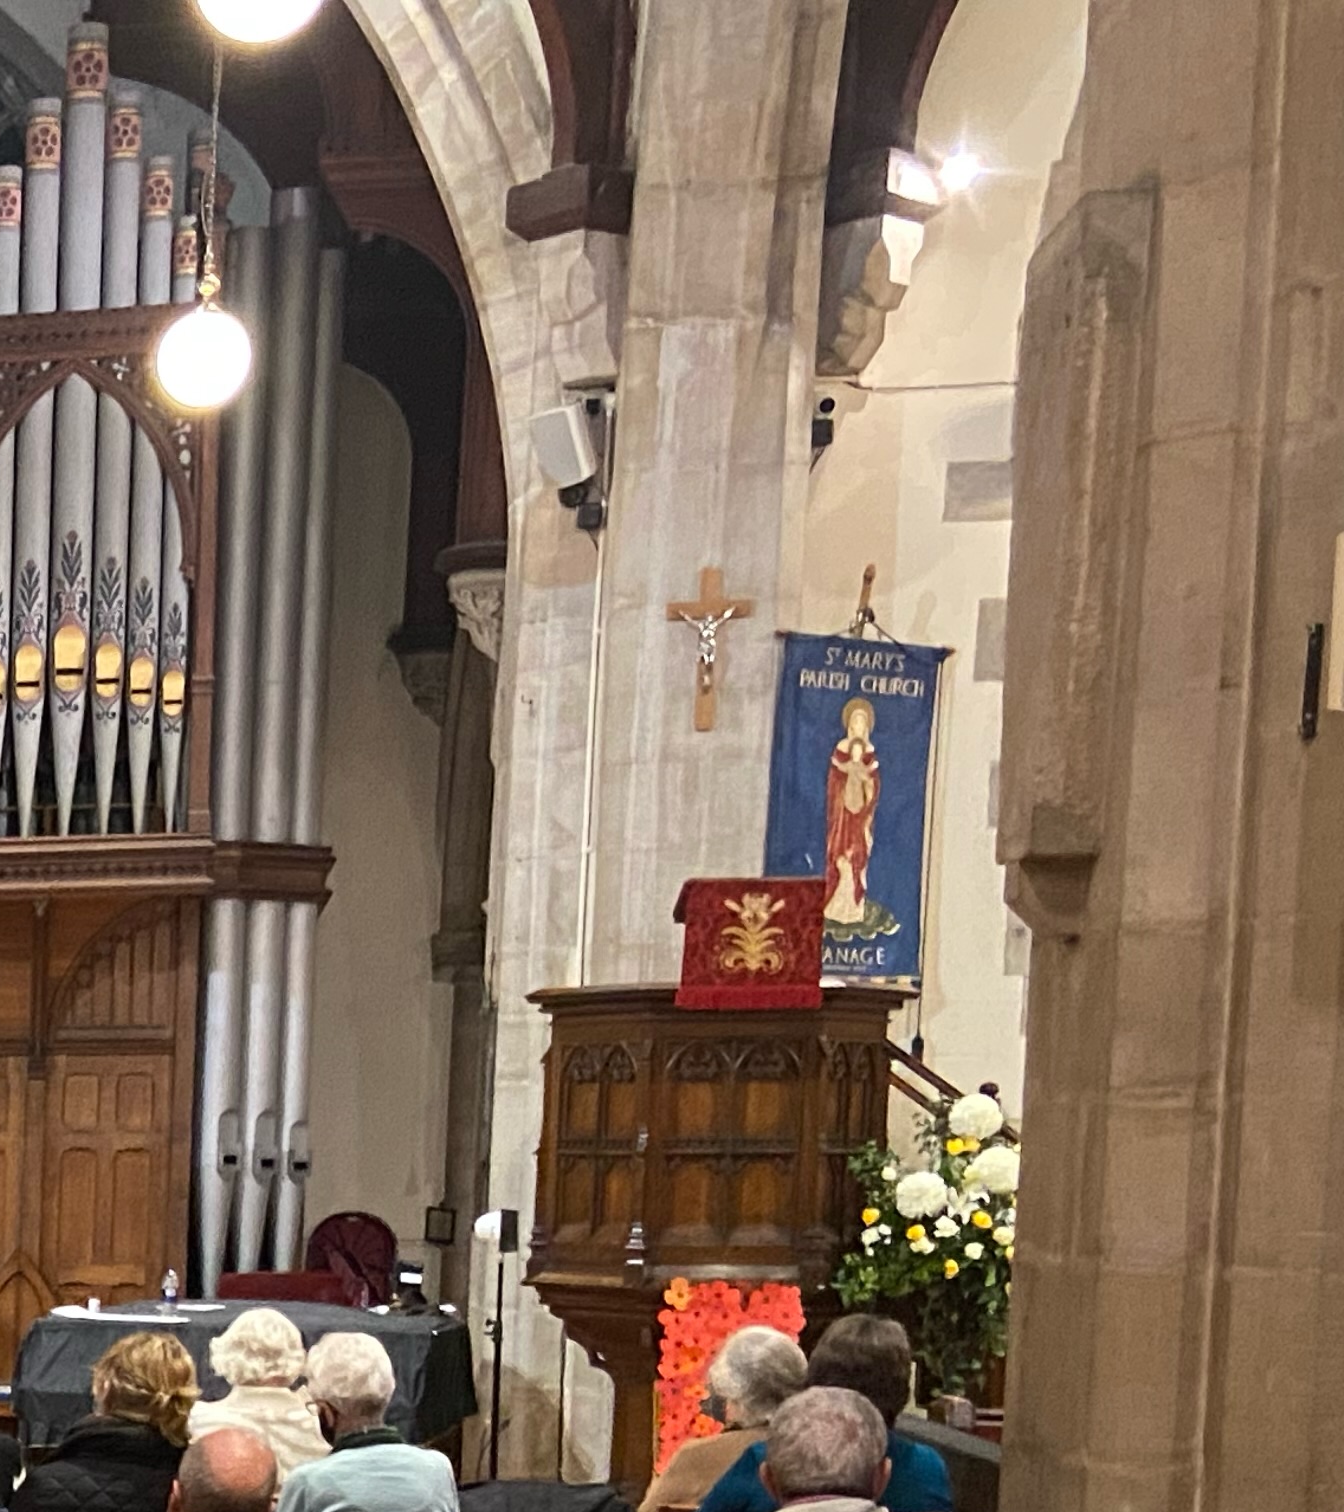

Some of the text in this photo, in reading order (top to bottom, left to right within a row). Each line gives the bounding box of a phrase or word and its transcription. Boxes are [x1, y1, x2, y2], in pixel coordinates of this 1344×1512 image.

[800, 669, 924, 697] PARISH CHURCH
[822, 945, 885, 965] ANAGE
